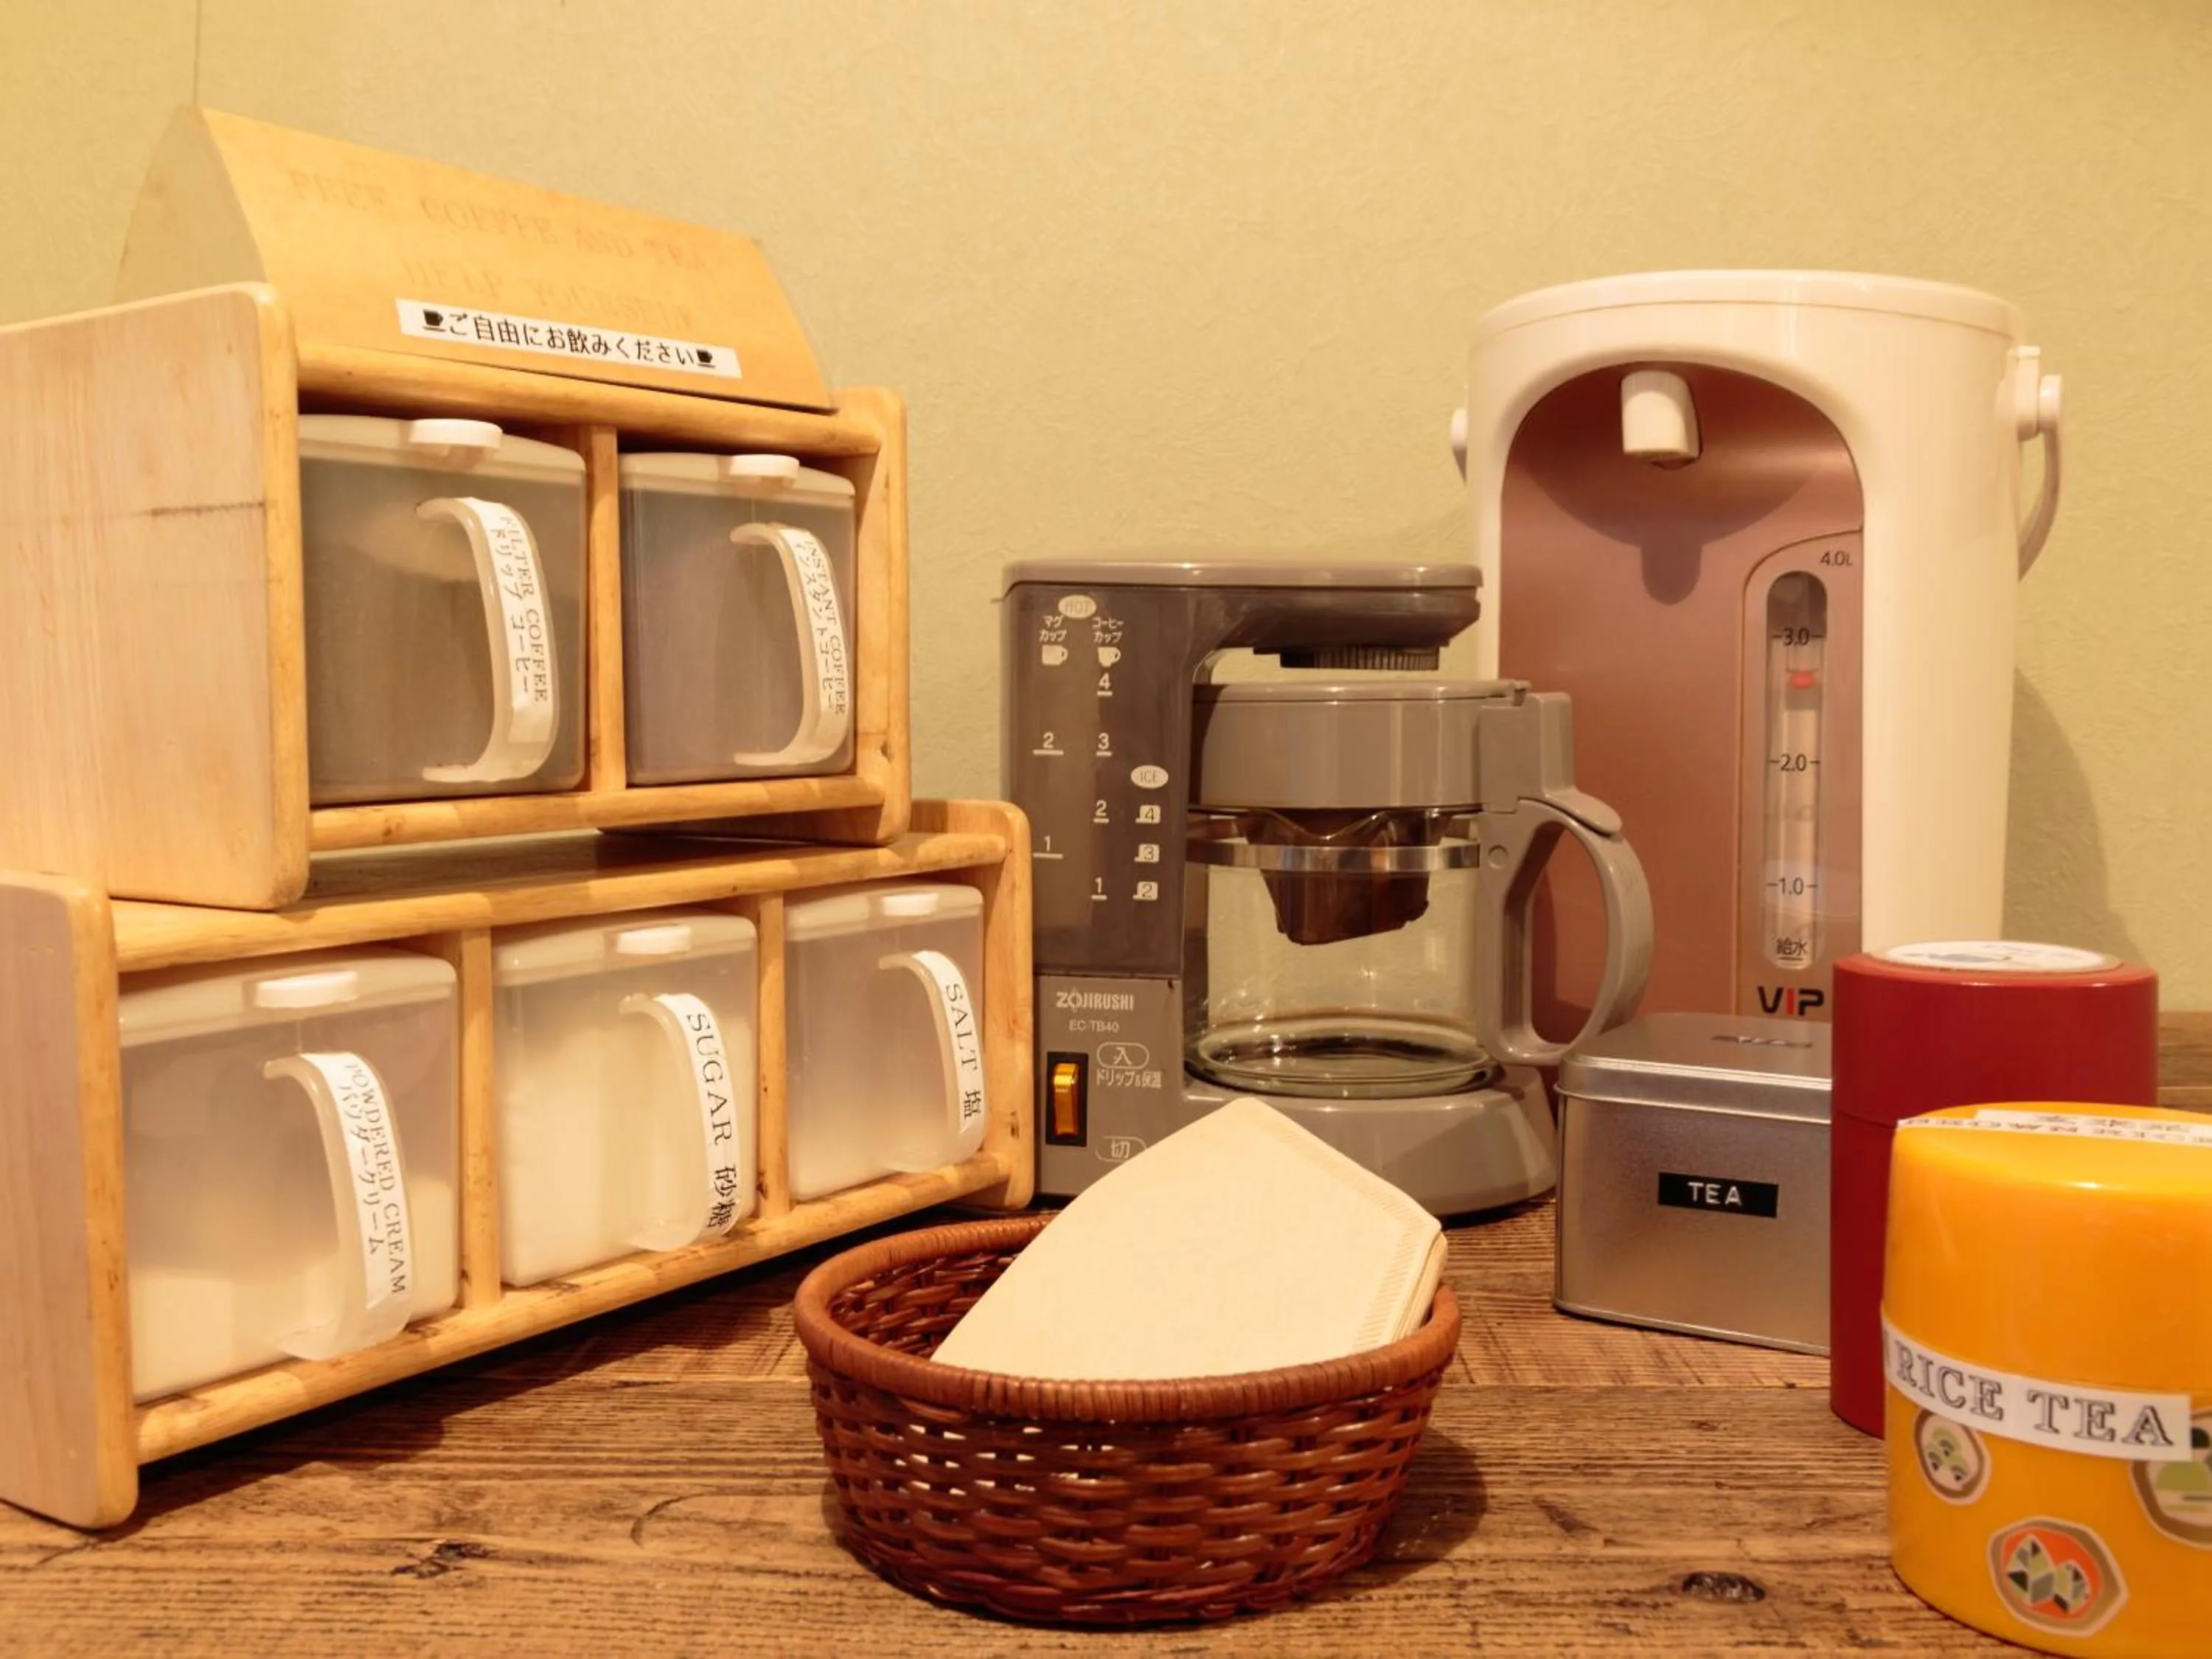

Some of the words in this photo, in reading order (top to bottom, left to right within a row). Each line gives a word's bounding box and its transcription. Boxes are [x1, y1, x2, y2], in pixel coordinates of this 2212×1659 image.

[449, 313, 695, 365] ご自由にお飲みください
[804, 540, 837, 626] INSTANT
[830, 634, 846, 716] COFFEE
[1783, 627, 1811, 646] 3.0
[526, 608, 548, 703] COFFEE
[1098, 674, 1110, 689] 4
[1043, 732, 1054, 748] 2
[1098, 733, 1110, 749] 3
[1781, 754, 1806, 772] 2.0
[1139, 769, 1159, 783] ICE
[1096, 800, 1107, 816] 2
[1144, 807, 1155, 821] 4
[1043, 835, 1051, 851] 1
[1144, 845, 1155, 860] 3
[1095, 877, 1102, 893] 1
[1142, 883, 1153, 897] 2
[1778, 877, 1804, 895] 1.0
[1776, 936, 1808, 956] 給水
[1056, 989, 1134, 1012] ZOJIRUSHI
[1757, 985, 1825, 1016] VIP
[1069, 1019, 1119, 1032] EC-TB40
[945, 982, 978, 1071] SALT
[963, 1090, 981, 1120] 塩
[1113, 1046, 1132, 1065] 入
[686, 1012, 733, 1145] SUGAR
[1110, 1139, 1131, 1158] 切
[344, 1063, 397, 1192] POWDERED
[383, 1202, 406, 1294] CREAM
[707, 1164, 737, 1228] 砂糖
[1688, 1181, 1742, 1206] TEA
[1893, 1339, 2004, 1422] RICE
[2026, 1388, 2174, 1447] TEA
